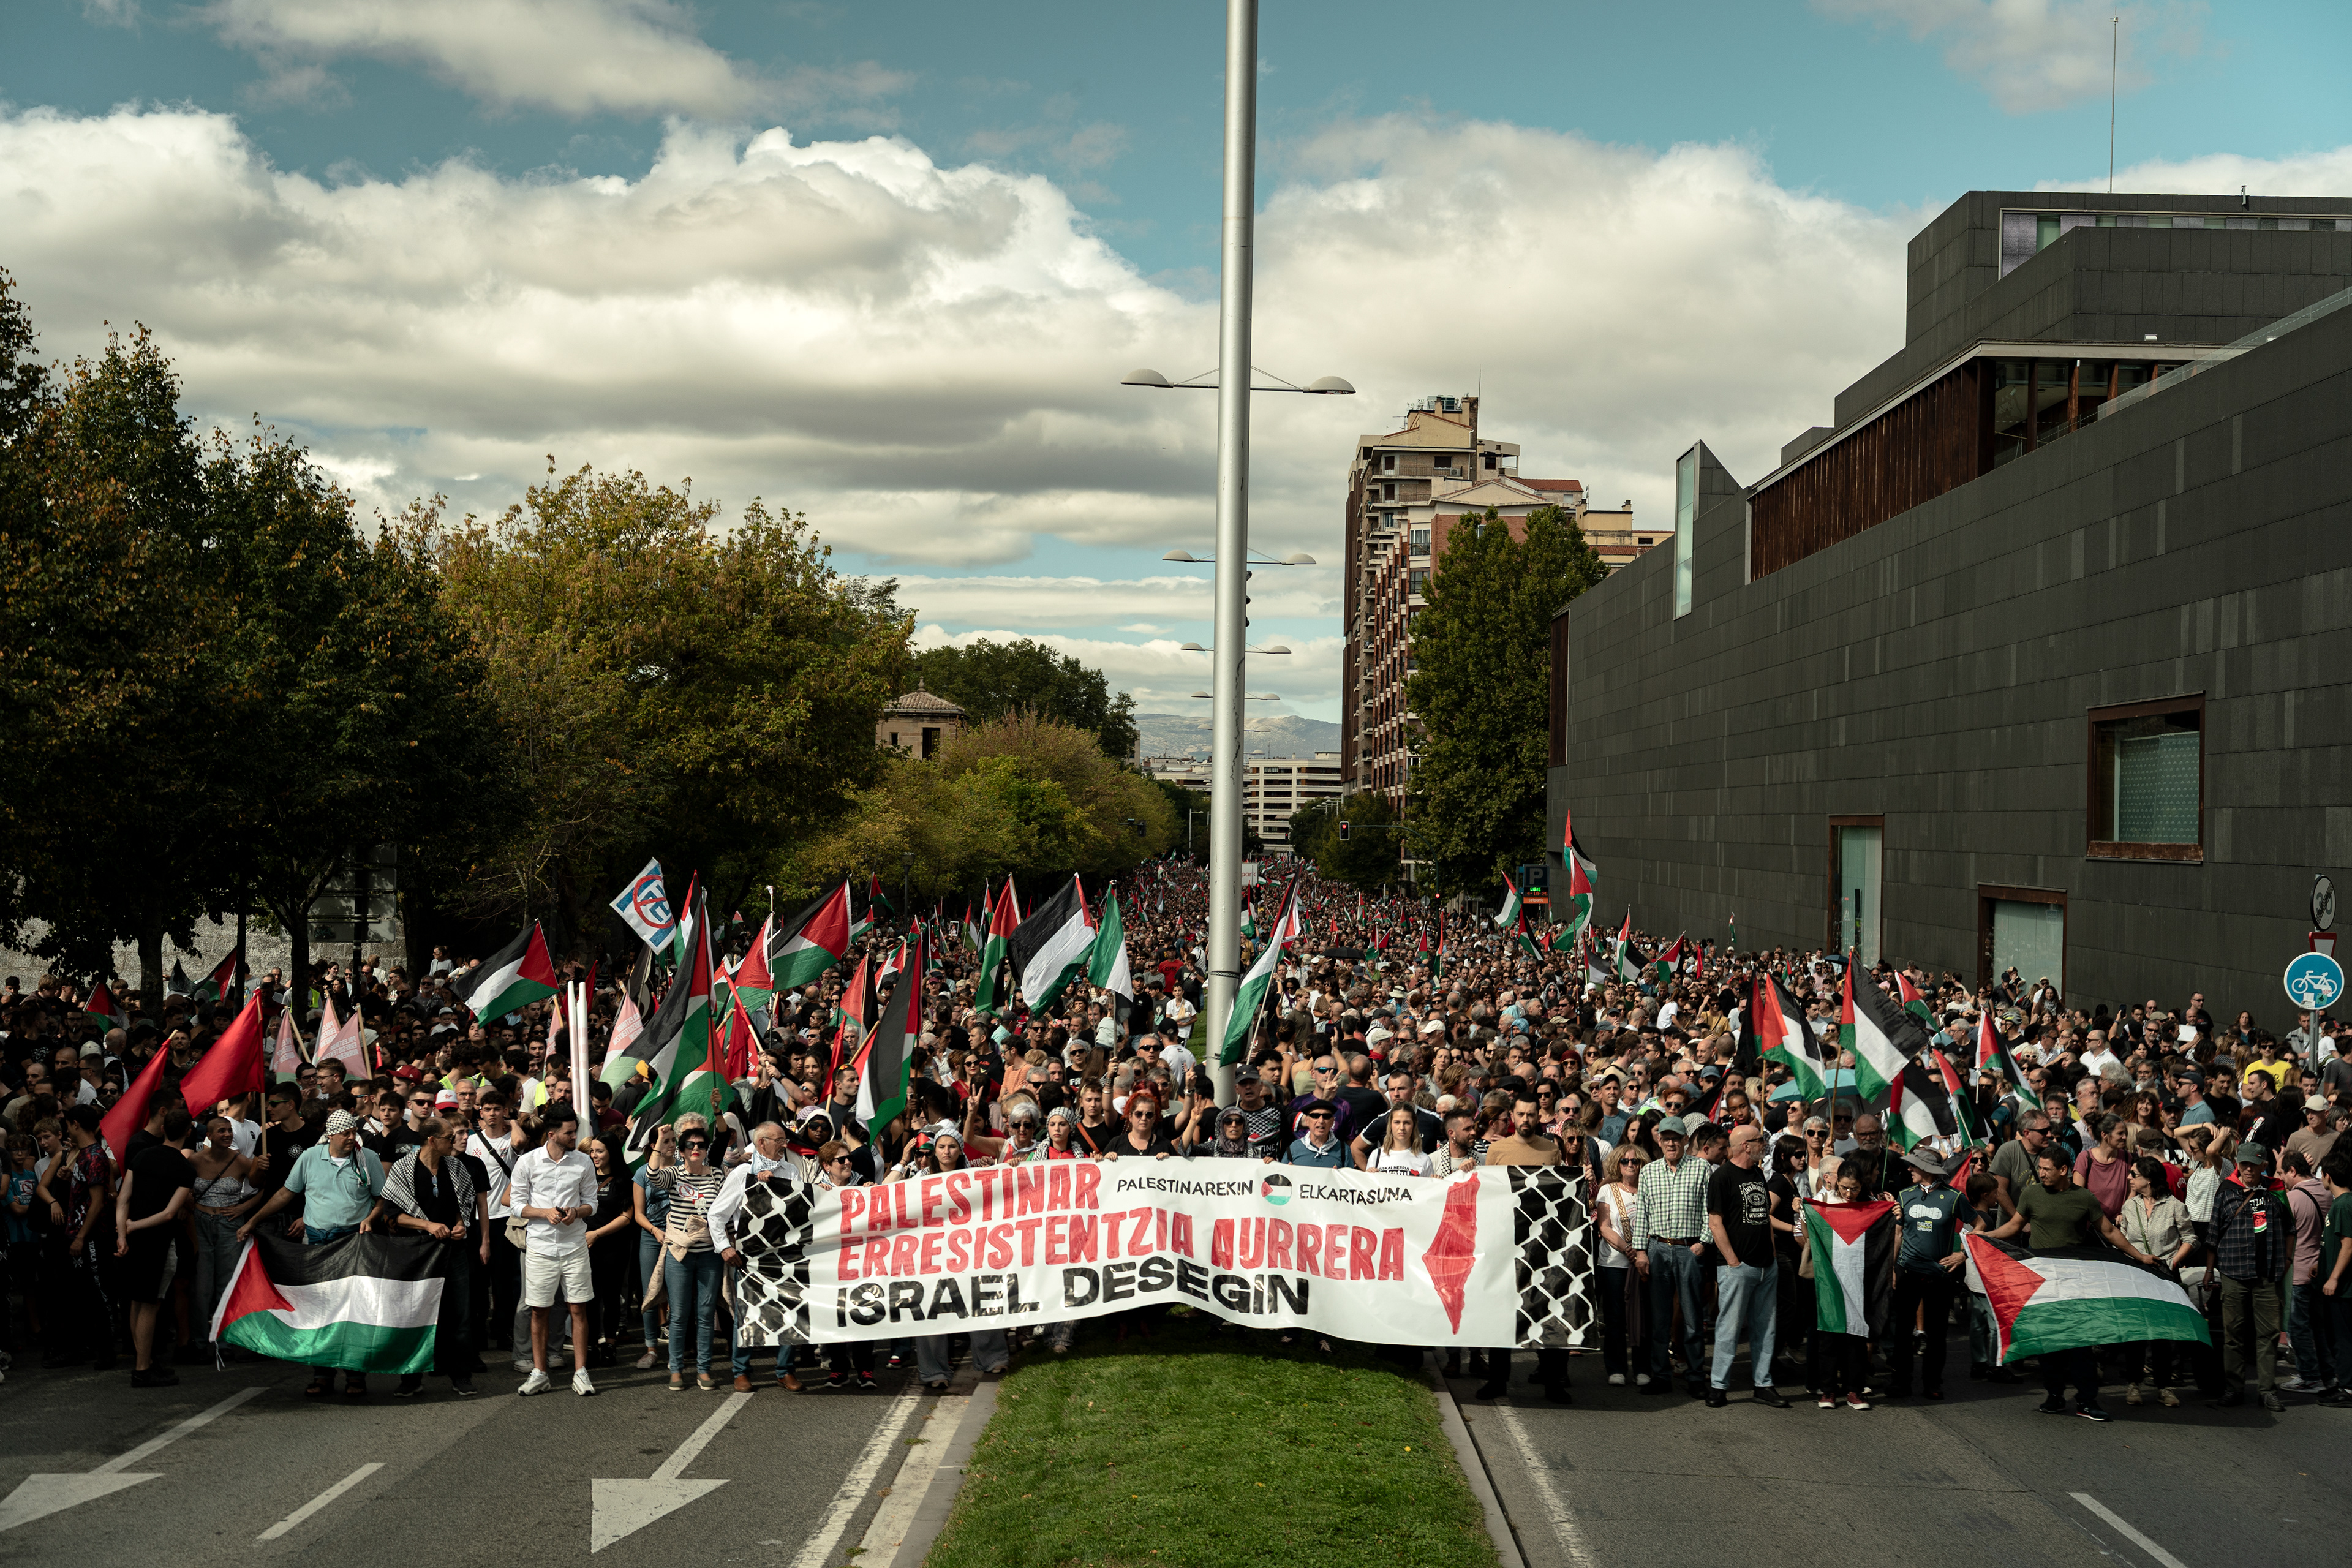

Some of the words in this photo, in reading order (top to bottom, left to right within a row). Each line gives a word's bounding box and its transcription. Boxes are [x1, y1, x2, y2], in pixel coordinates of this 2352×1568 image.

[1529, 868, 1543, 884] P
[2316, 892, 2332, 915] 30
[840, 1163, 1101, 1234] PALESTINAR
[1117, 1177, 1253, 1196] PALESTINAREKIN
[1300, 1183, 1412, 1205] ELKARTASUNA
[838, 1206, 1194, 1281] ERRESISTENTZIA
[1211, 1217, 1404, 1281] AURRERA
[837, 1273, 1040, 1327] ISRAEL
[1063, 1256, 1309, 1315] DESEGIN
